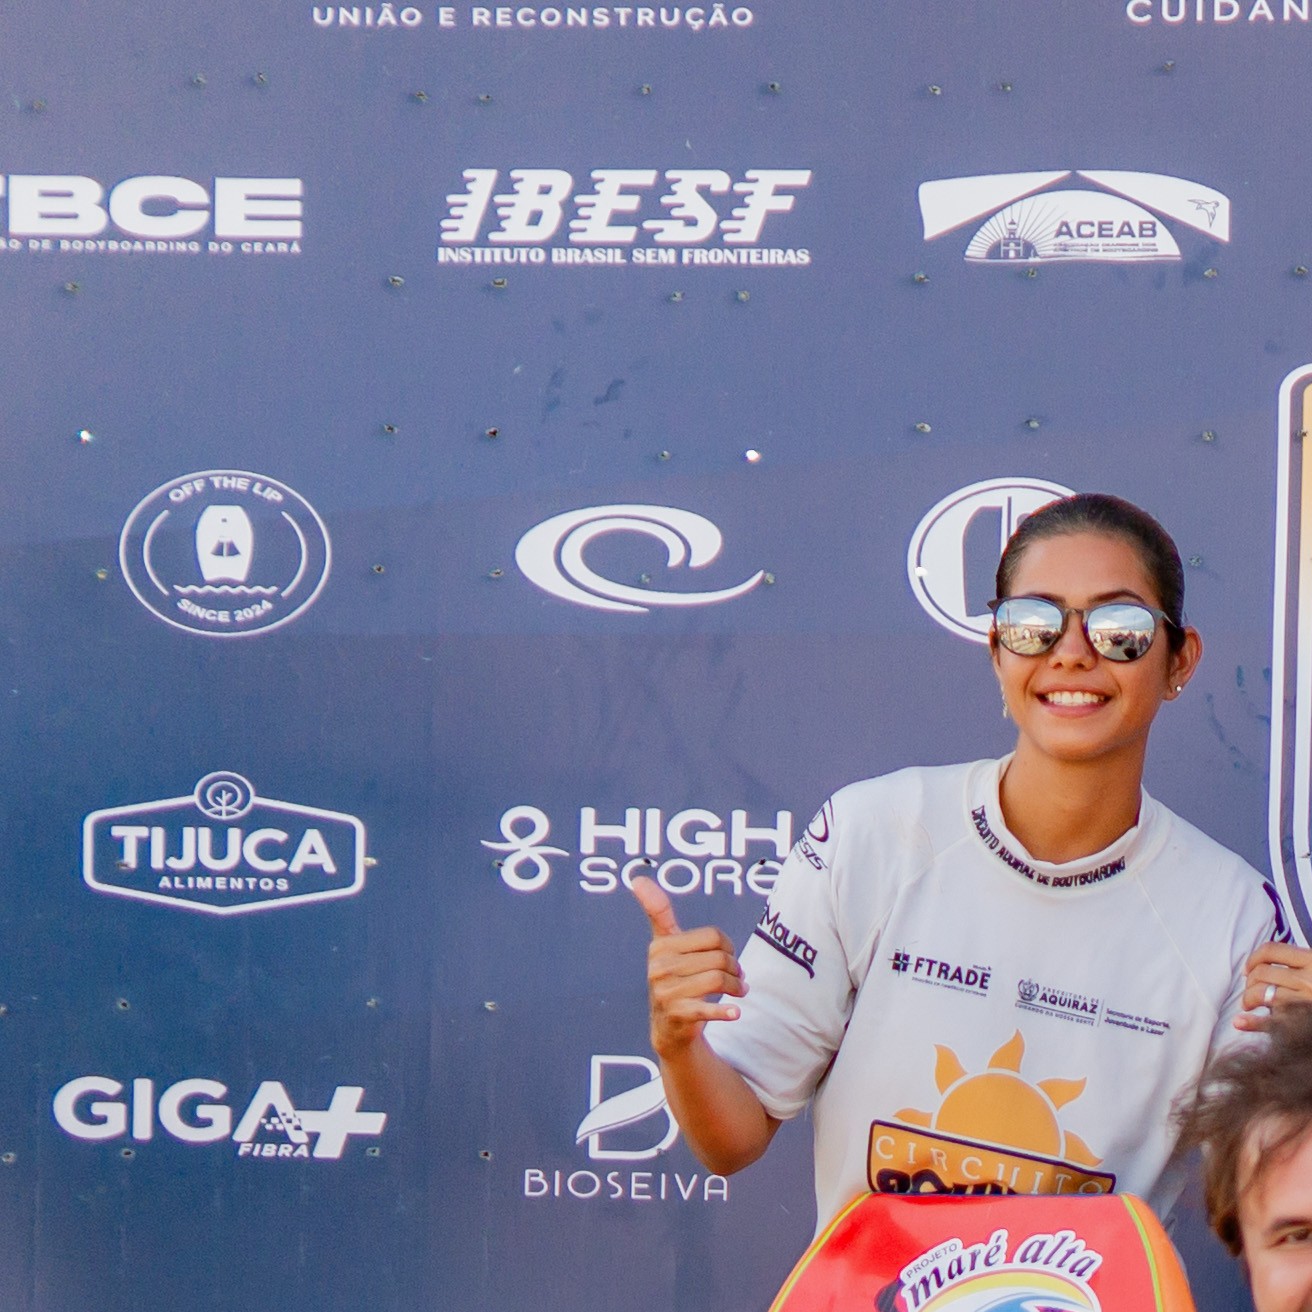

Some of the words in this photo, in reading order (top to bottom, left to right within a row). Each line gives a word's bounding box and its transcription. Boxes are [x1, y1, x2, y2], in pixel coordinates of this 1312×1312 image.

[312, 2, 423, 28] UNIÃO
[439, 7, 457, 28] E
[471, 2, 755, 31] RECONSTRUÇÃO
[0, 173, 303, 238] BCE
[439, 169, 812, 243] IBESF
[1053, 219, 1158, 239] ACEAB
[28, 239, 51, 250] DE
[59, 239, 200, 252] BODYBOARDING
[207, 241, 233, 252] DO
[240, 238, 302, 253] CEARÁ
[437, 246, 546, 265] INSTITUTO
[551, 247, 627, 265] BRASIL
[632, 247, 676, 265] SEM
[682, 248, 811, 266] FRONTEIRAS
[168, 480, 206, 502] OFF
[209, 476, 250, 492] THE
[251, 481, 284, 502] LIP
[176, 598, 231, 623] SINCE
[233, 599, 274, 622] 2024
[579, 805, 793, 858] HIGH
[110, 825, 338, 874] TIJUCA
[157, 875, 290, 892] ALIMENTOS
[914, 956, 992, 990] FTRADE
[1039, 992, 1098, 1014] AQUIRAZ
[238, 1142, 310, 1158] FIBRA
[523, 1168, 730, 1202] BIOSEIVA
[905, 1242, 959, 1280] PROJETO
[907, 1233, 1004, 1308] maré
[1019, 1233, 1097, 1278] alta
